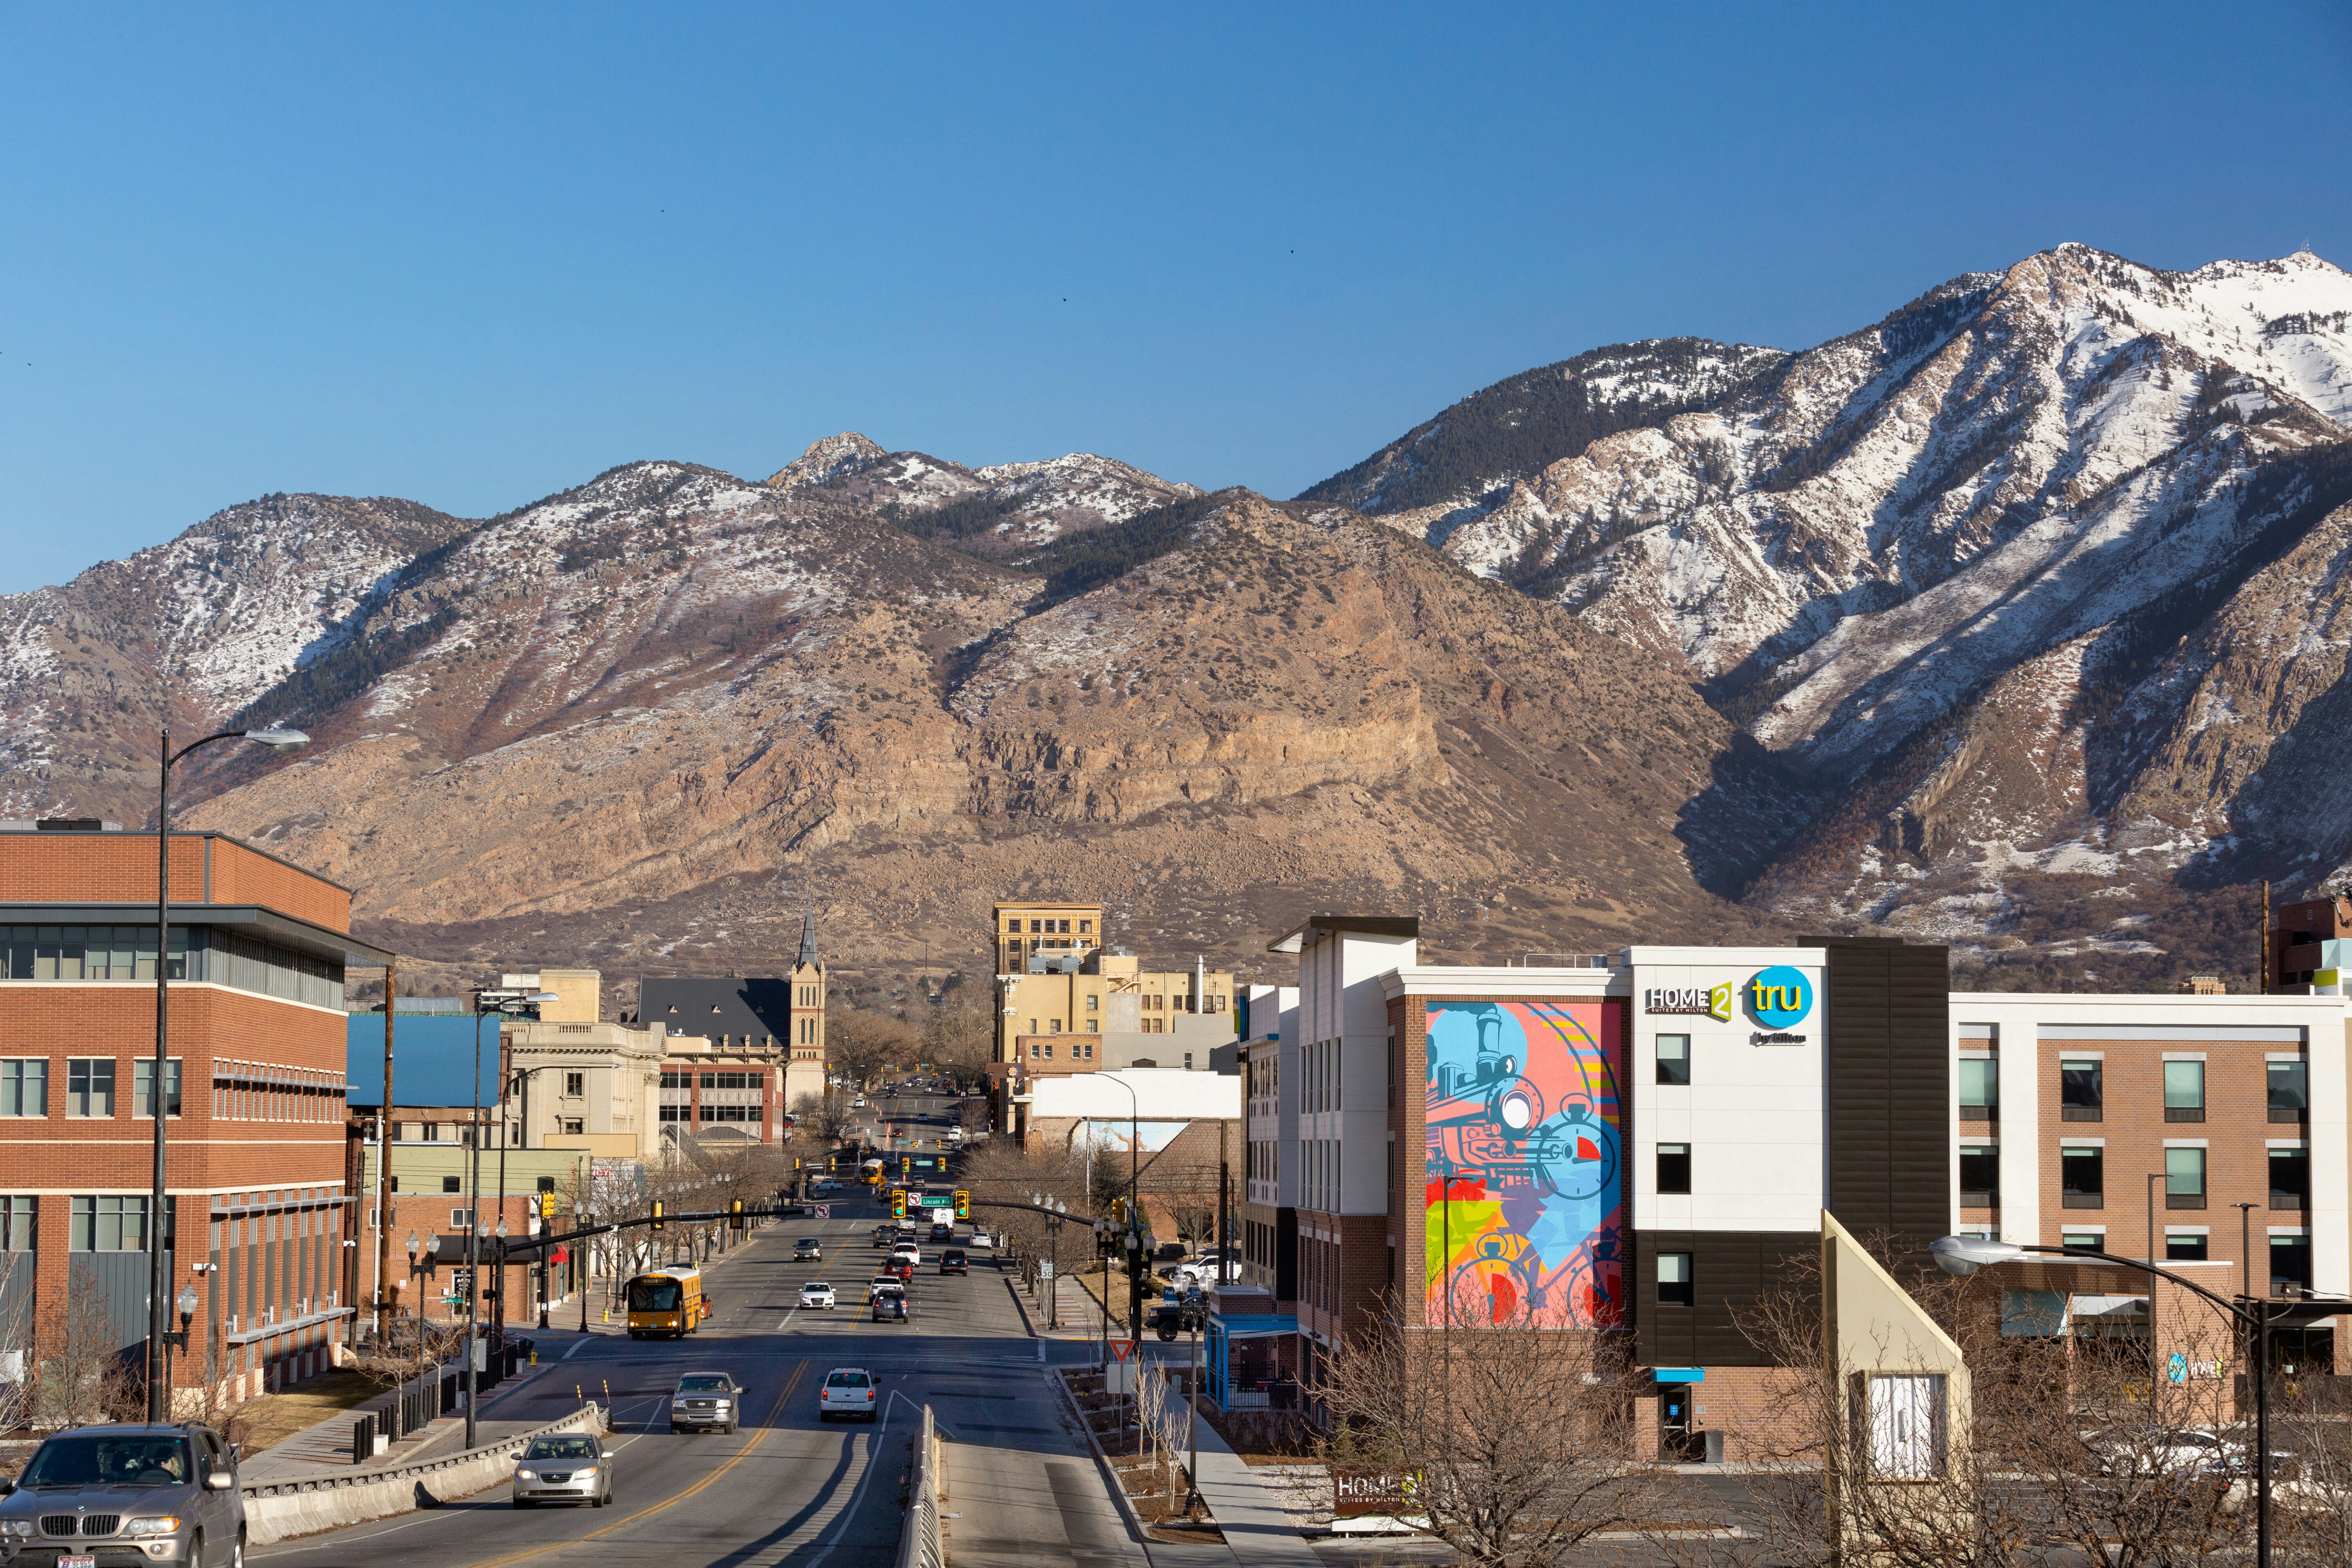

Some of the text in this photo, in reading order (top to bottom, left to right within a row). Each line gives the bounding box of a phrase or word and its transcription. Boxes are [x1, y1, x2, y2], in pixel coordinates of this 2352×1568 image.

[1651, 987, 1729, 1017] HOME 2
[1752, 980, 1801, 1010] tru
[1758, 1033, 1806, 1044] by Hilton
